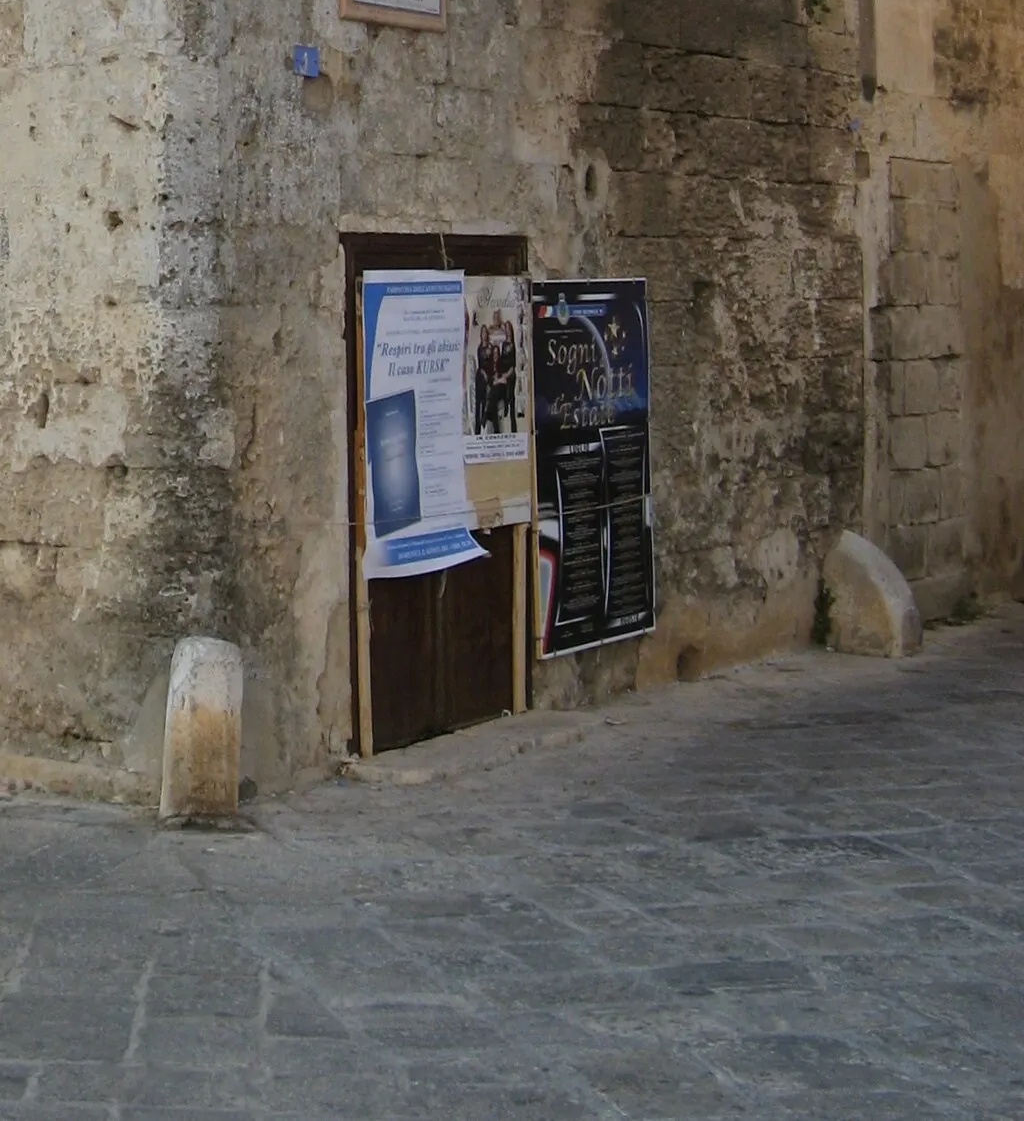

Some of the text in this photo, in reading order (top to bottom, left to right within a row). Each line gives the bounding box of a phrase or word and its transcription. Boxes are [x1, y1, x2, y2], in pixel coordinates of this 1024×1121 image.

[400, 68, 416, 87] 20
[388, 362, 396, 377] Il
[397, 365, 415, 376] caso
[547, 336, 597, 376] Sogni
[574, 363, 634, 401] Notti
